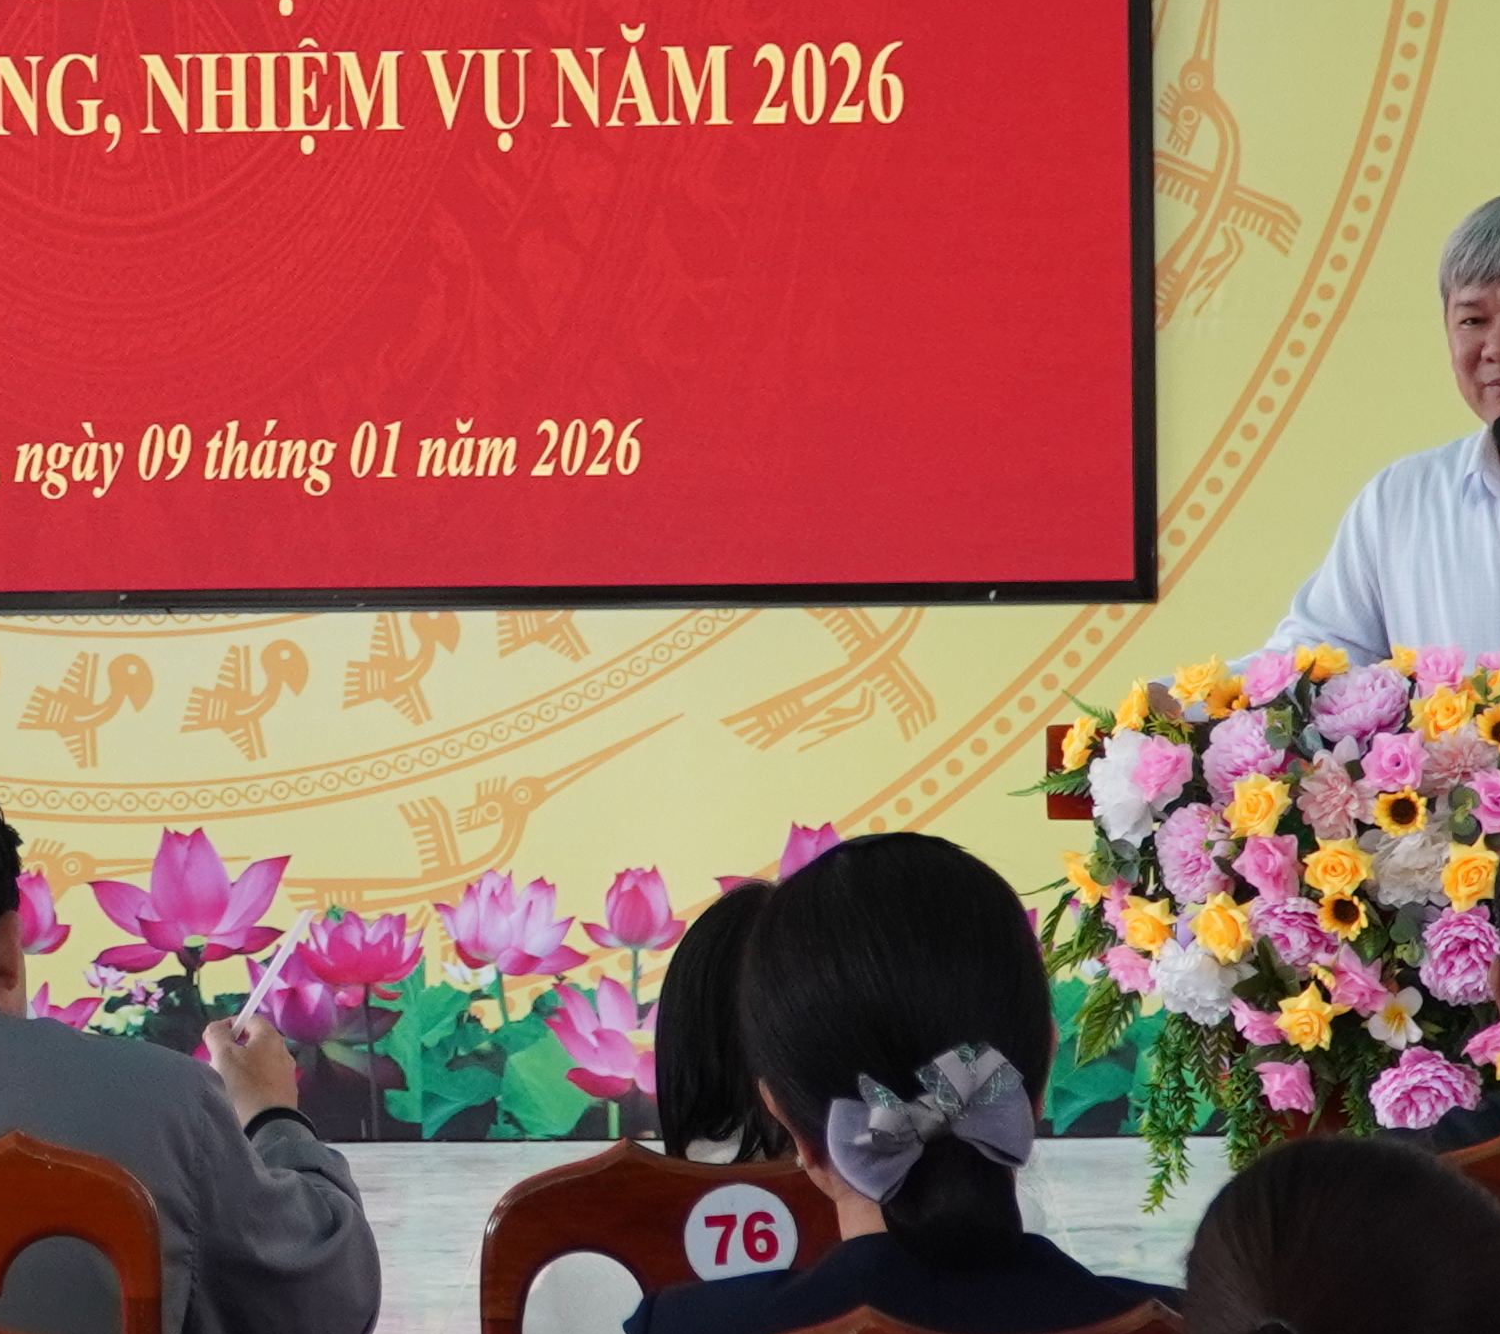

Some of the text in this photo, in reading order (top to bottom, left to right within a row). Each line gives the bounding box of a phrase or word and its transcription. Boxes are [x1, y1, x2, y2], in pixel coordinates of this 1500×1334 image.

[139, 37, 406, 156] NHIỆM
[420, 48, 532, 153] VỤ
[550, 22, 734, 128] NĂM
[752, 40, 904, 125] 2026
[13, 421, 125, 500] ngày
[137, 423, 192, 481] 09
[204, 419, 338, 497] tháng
[349, 420, 402, 479] 01
[416, 417, 517, 478] năm
[530, 417, 643, 477] 2026
[706, 1212, 779, 1265] 76
